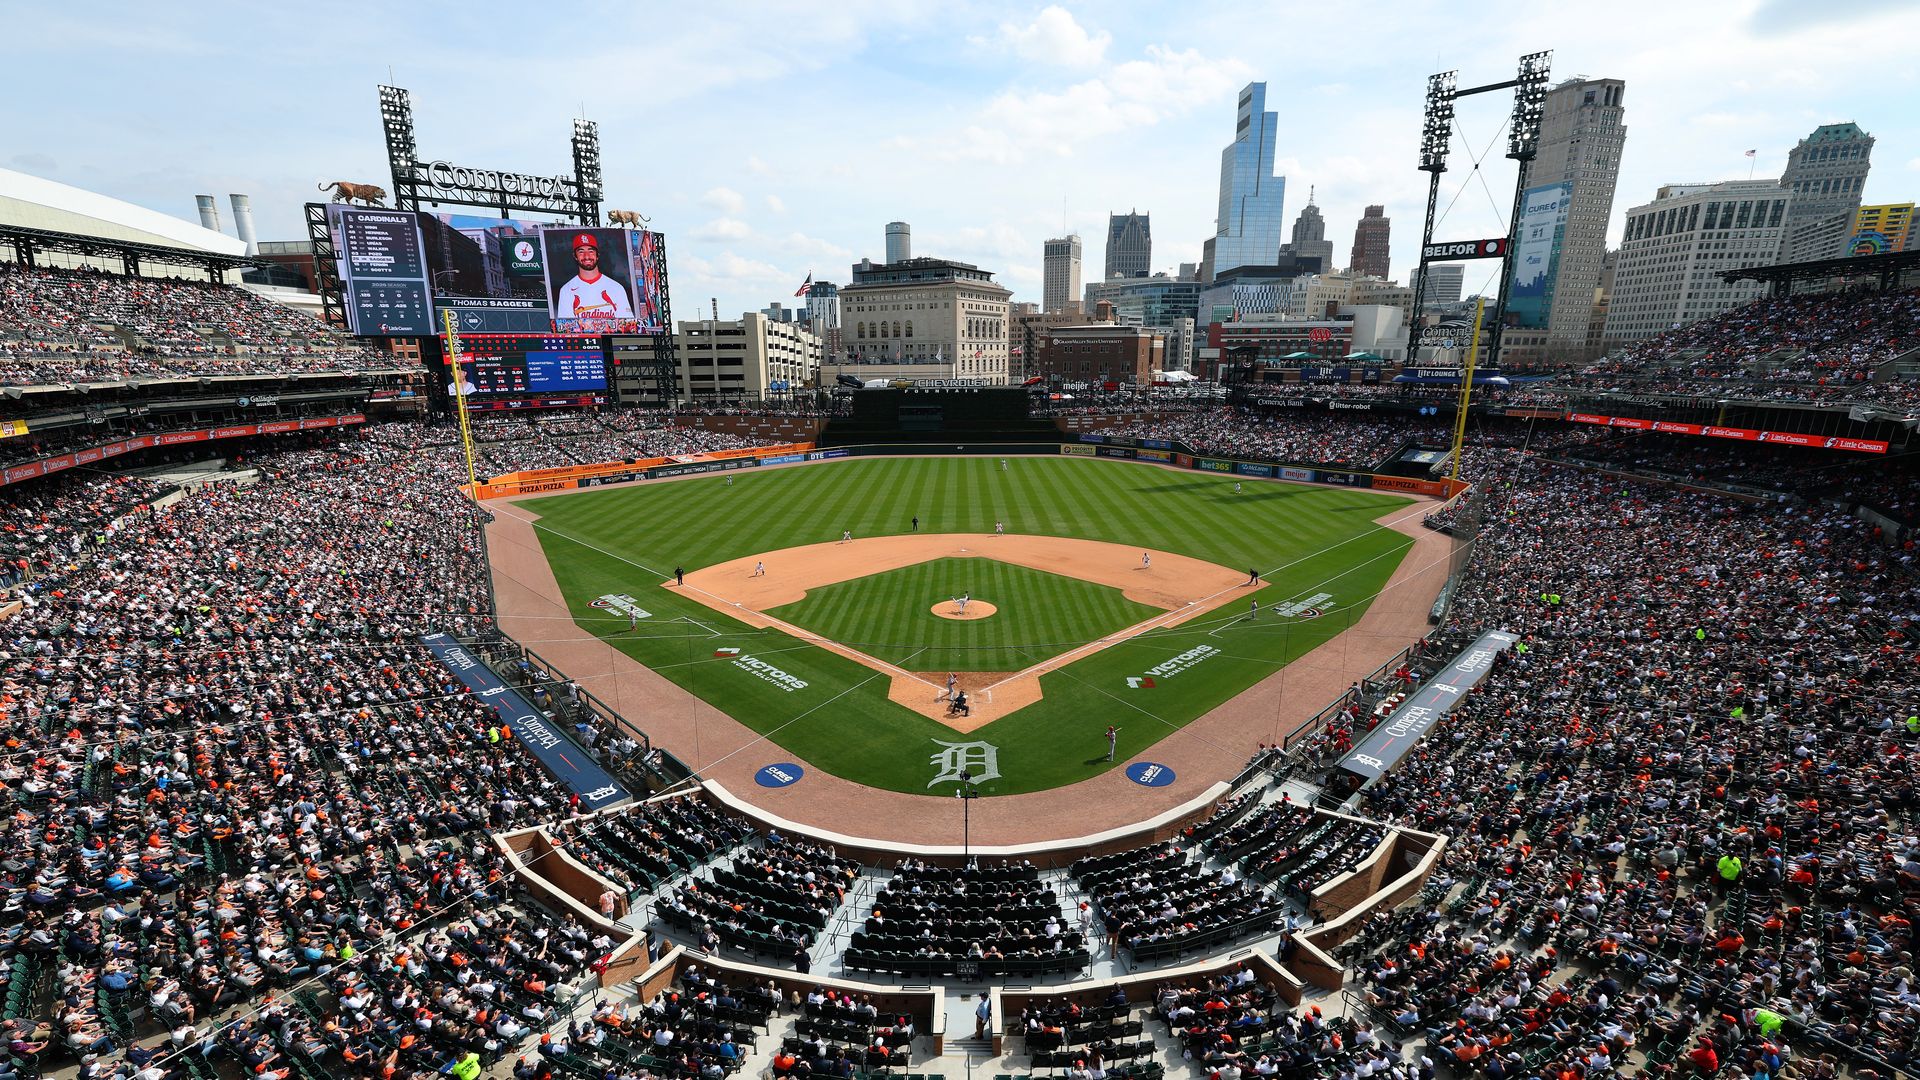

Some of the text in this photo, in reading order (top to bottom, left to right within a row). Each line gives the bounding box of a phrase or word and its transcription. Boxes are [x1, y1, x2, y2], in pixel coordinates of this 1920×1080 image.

[473, 192, 538, 206] PARK
[1532, 228, 1543, 238] #1
[1425, 244, 1475, 257] BELFOR
[1310, 328, 1332, 341] AAA
[1423, 328, 1466, 337] Comeri
[1463, 312, 1476, 349] Rocket
[918, 379, 990, 387] CHEVROLET
[1063, 382, 1088, 391] meijer
[1840, 440, 1883, 451] Little Caesars
[1202, 461, 1229, 470] bet365
[1285, 470, 1307, 478] meijer
[519, 482, 564, 494] PIZZA! PIZZA!
[1374, 479, 1395, 487] PIZZA!
[1396, 481, 1419, 489] PIZZA!
[1144, 645, 1212, 676] VICTORS
[1162, 649, 1221, 678] HOME SOLUTIONS
[731, 660, 794, 692] HOME SOLUTIONS
[740, 655, 808, 688] VICTORS
